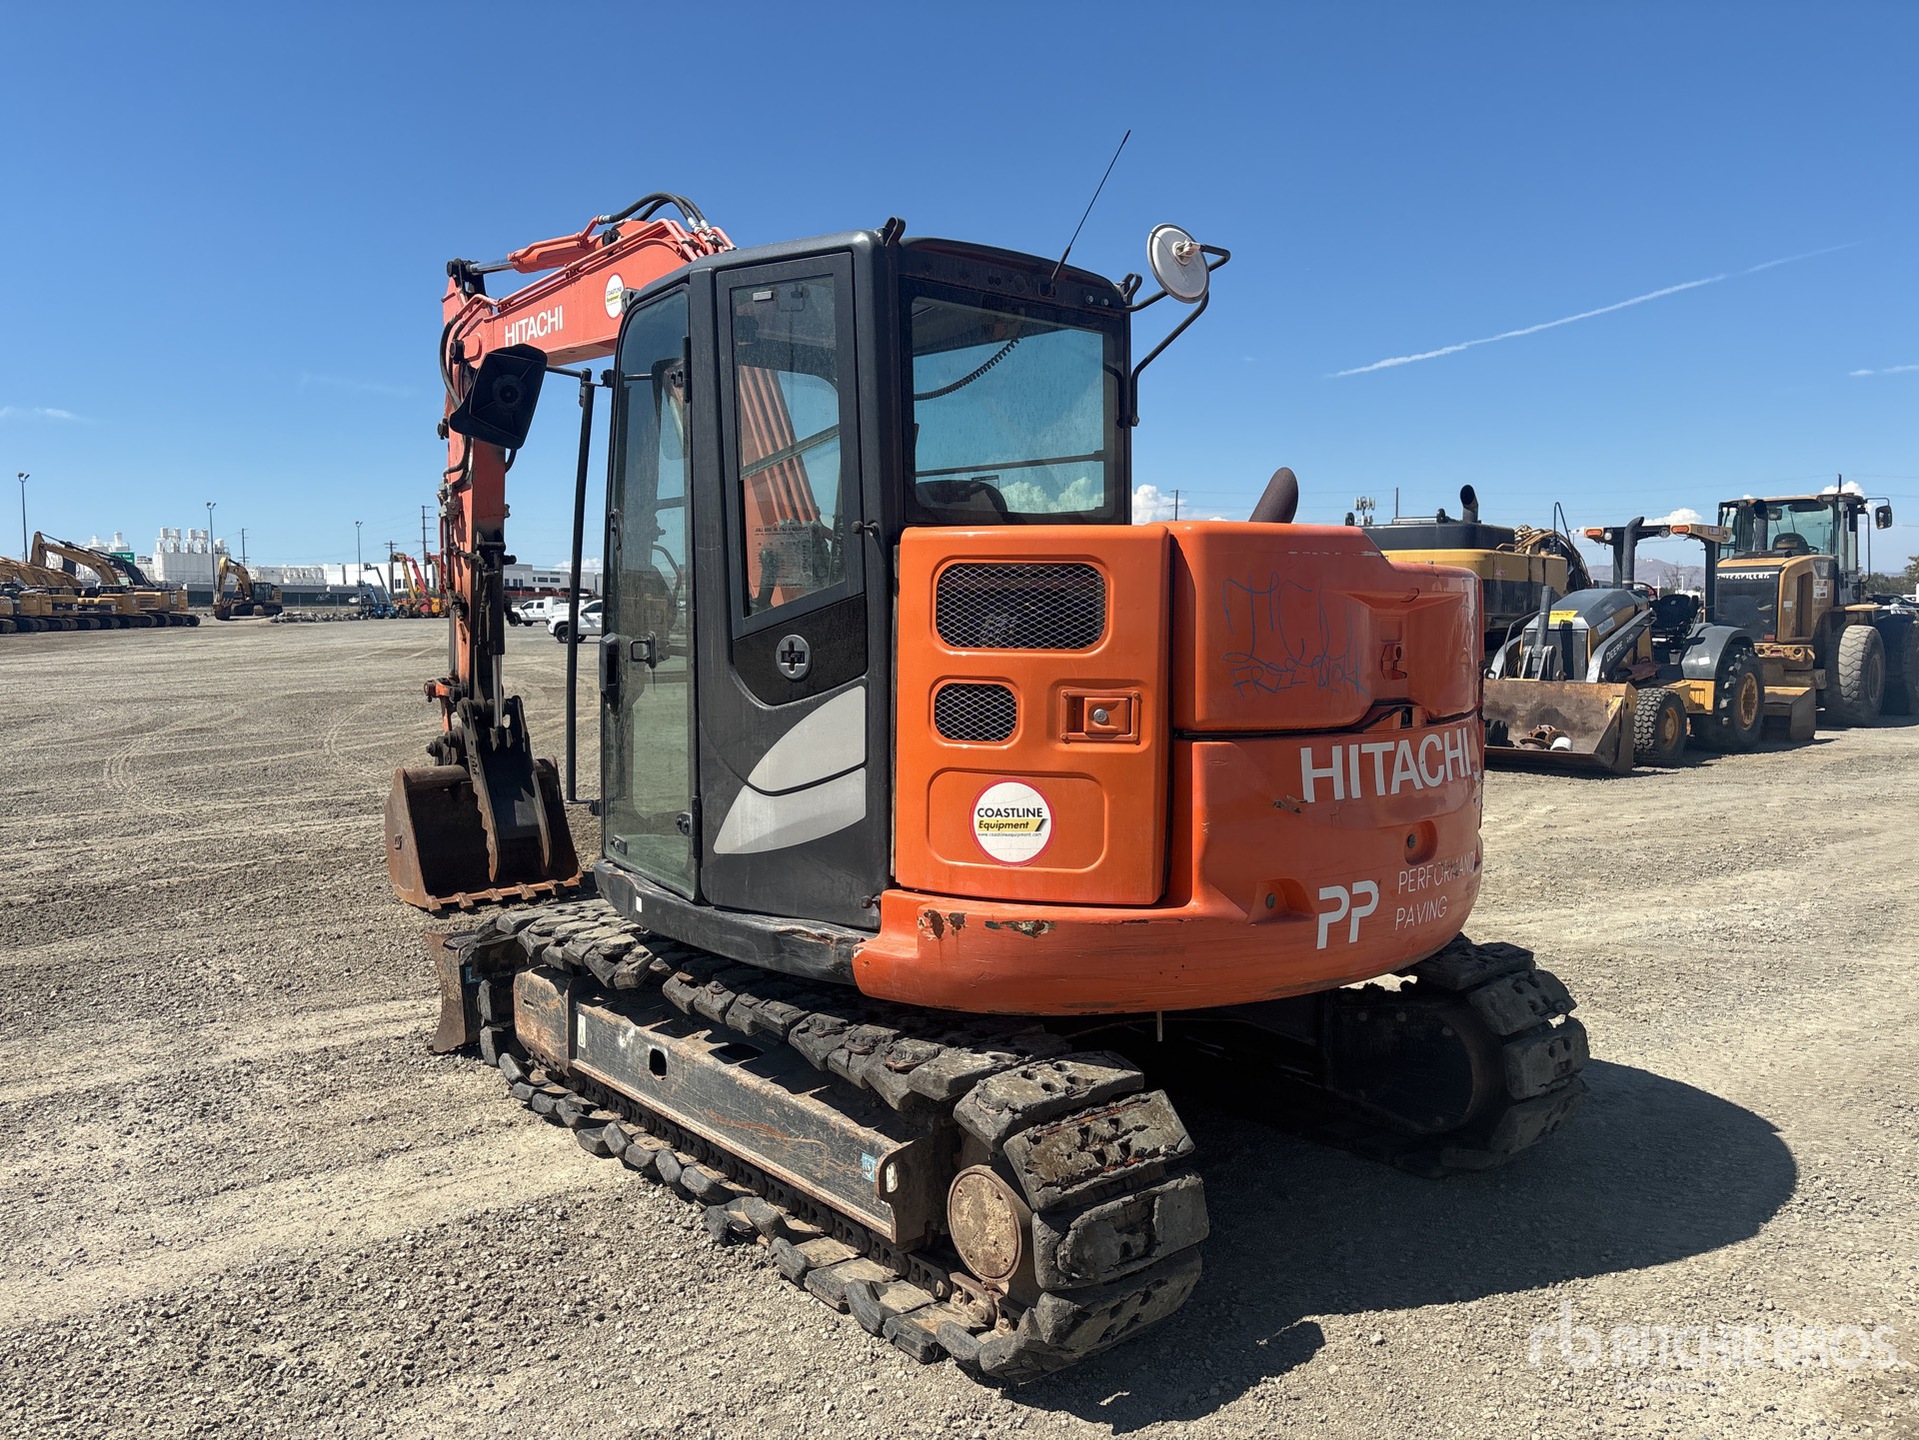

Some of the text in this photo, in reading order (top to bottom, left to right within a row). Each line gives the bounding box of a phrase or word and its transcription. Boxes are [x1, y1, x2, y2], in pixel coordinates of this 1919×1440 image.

[505, 305, 563, 347] HITACHI
[1606, 640, 1623, 662] DEERE
[1300, 727, 1472, 803] HITACHI
[977, 807, 1043, 818] COASTLINE
[979, 819, 1029, 831] Equipment
[1316, 880, 1380, 950] PP
[1395, 895, 1448, 931] PAVING
